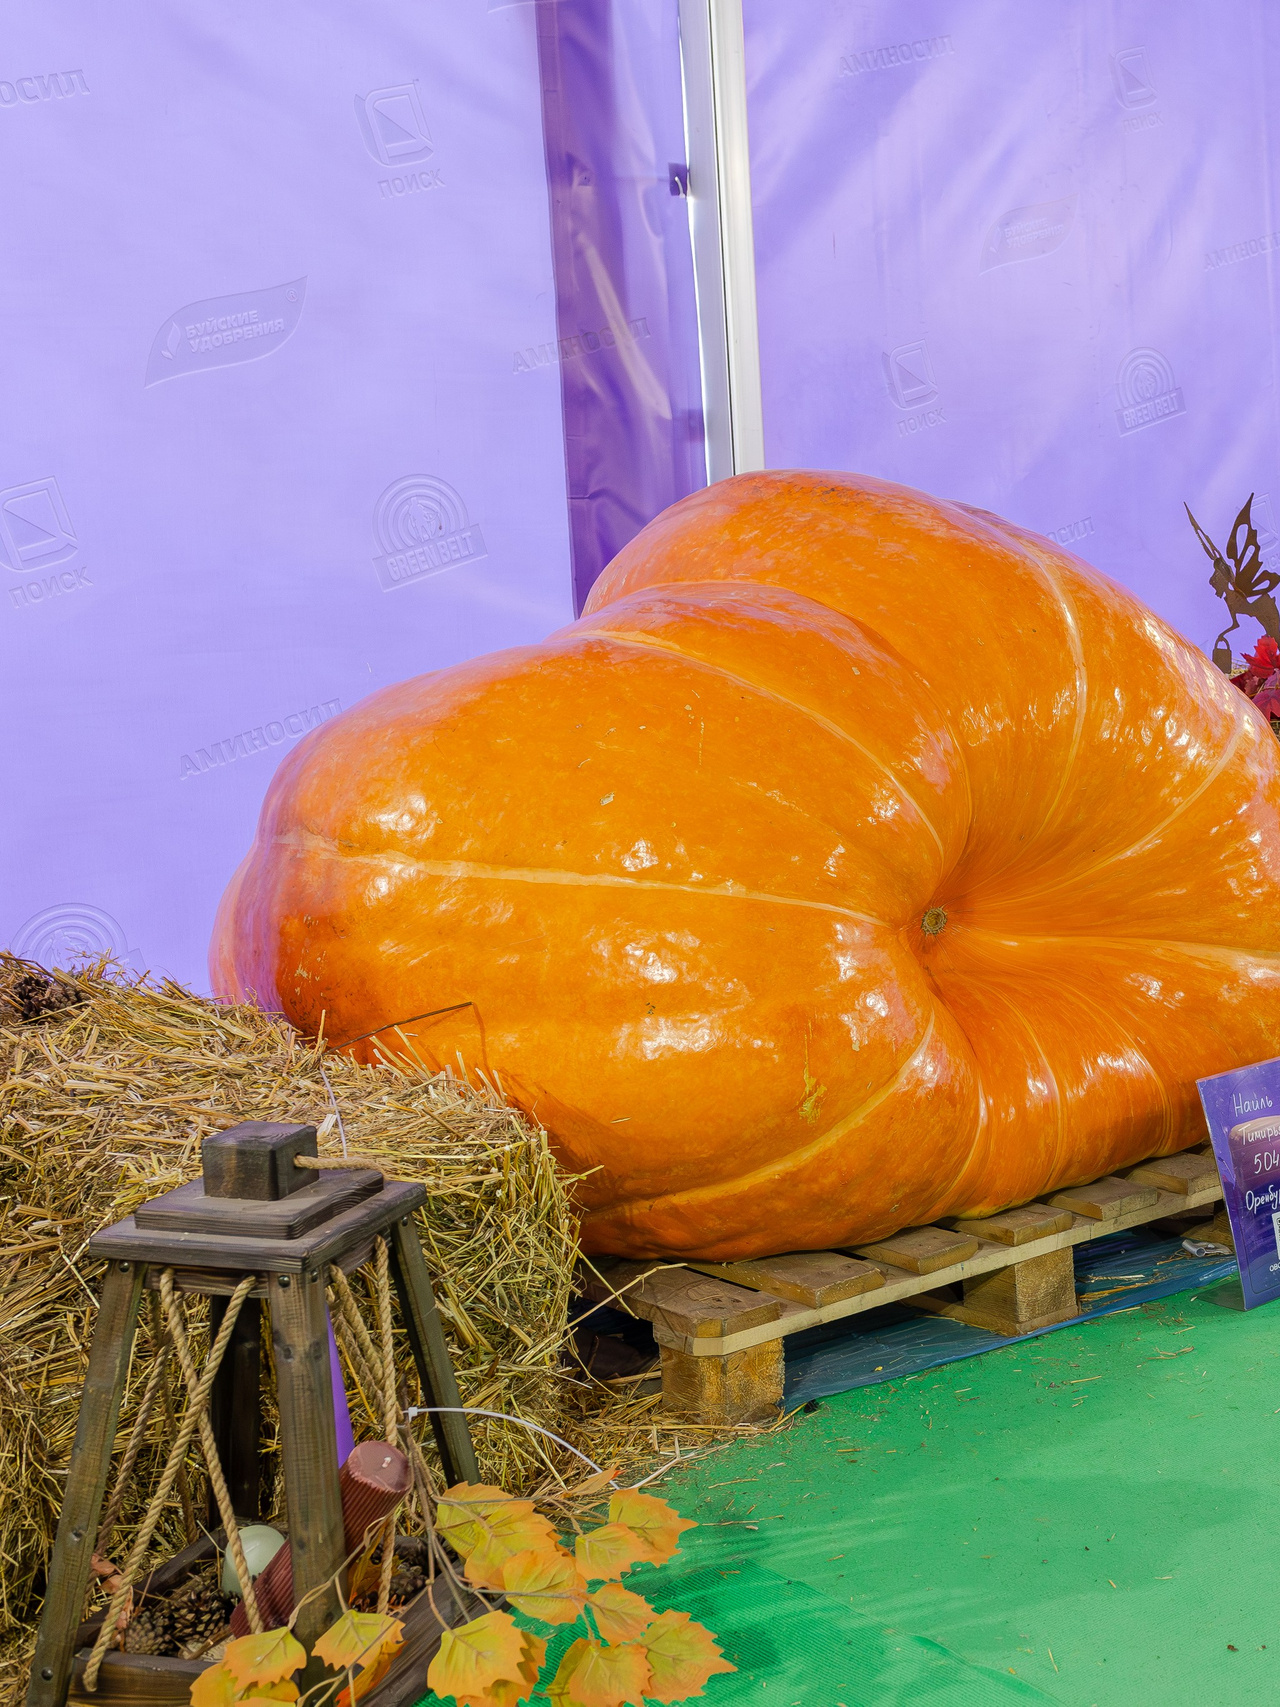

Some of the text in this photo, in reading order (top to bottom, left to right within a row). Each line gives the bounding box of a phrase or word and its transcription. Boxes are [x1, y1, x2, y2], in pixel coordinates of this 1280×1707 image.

[839, 34, 956, 79] АМИНОСИЛ
[1121, 110, 1164, 135] ПОИСК
[377, 167, 446, 200] ПОИСК
[184, 308, 260, 340] БУЙСКИЕ
[187, 317, 286, 353] УДОБРЕНИЯ
[896, 407, 948, 438] ПОИСК
[386, 530, 475, 581] GREEN BELT
[7, 563, 95, 609] ПОИСК
